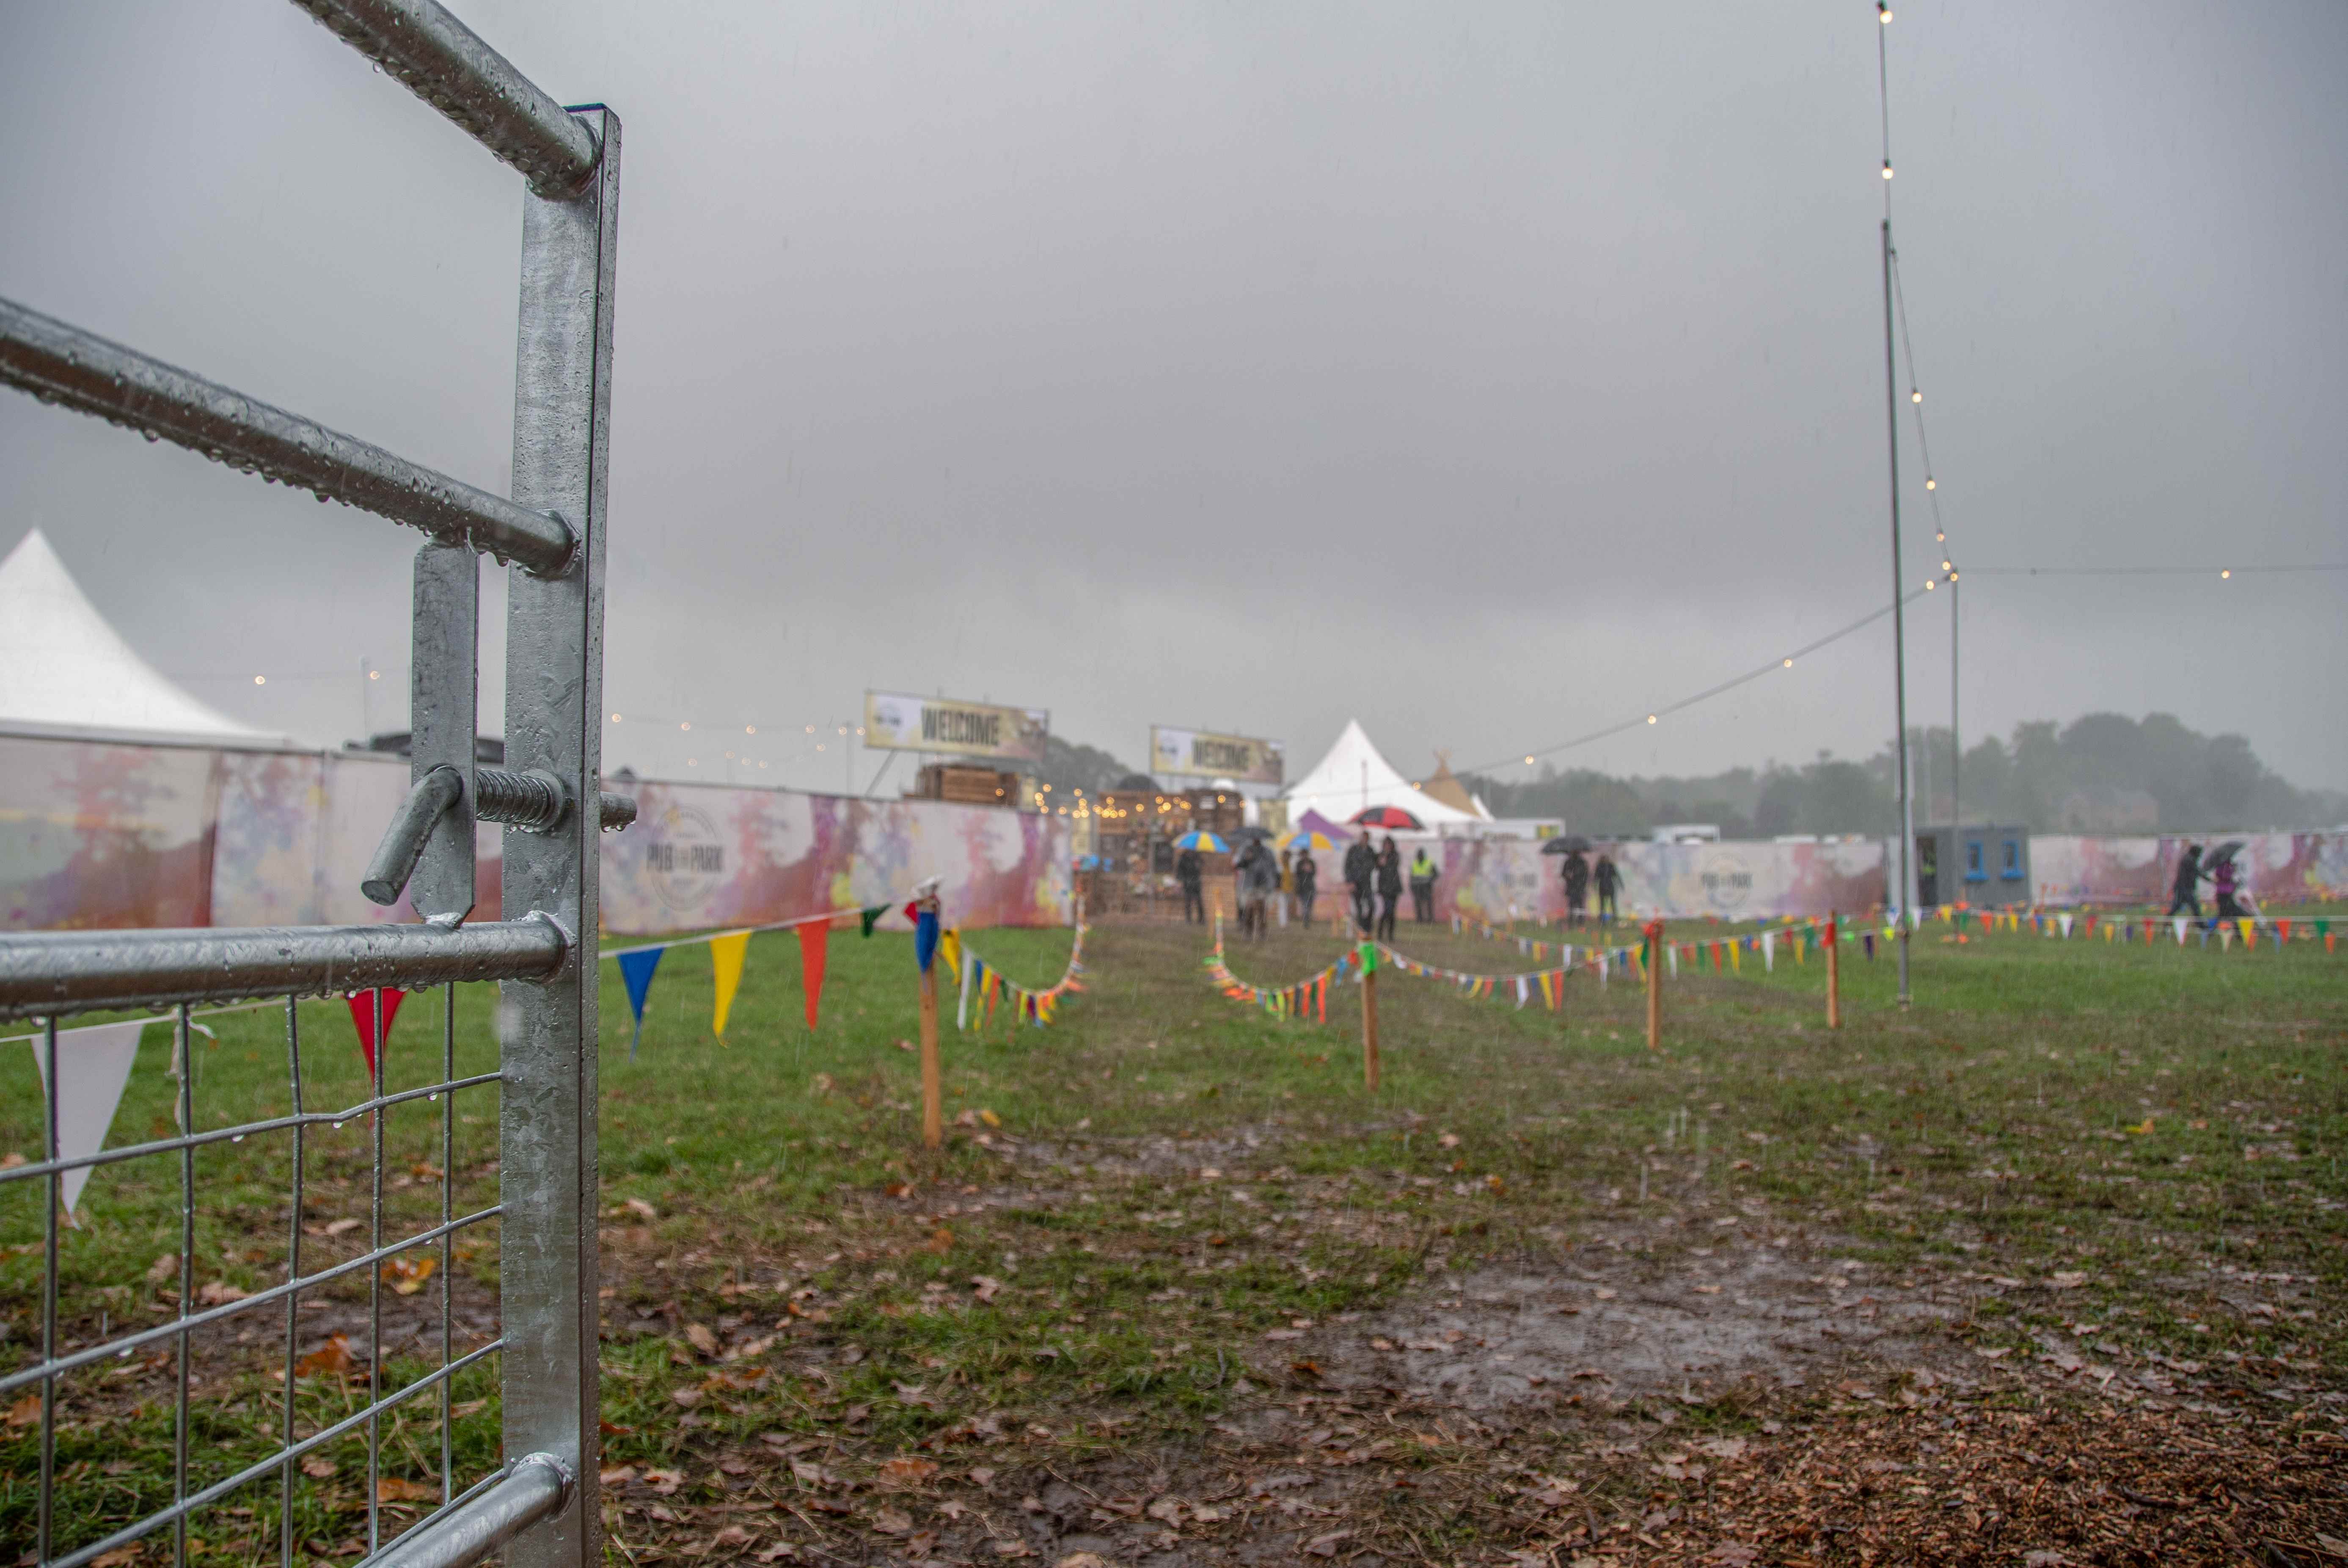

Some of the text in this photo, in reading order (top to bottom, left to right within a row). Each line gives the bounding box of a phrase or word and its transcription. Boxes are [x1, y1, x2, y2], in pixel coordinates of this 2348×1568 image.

[921, 705, 999, 746] WELCOME
[1192, 739, 1249, 771] WELCOME
[647, 844, 674, 872] PUB
[691, 845, 724, 872] PARK
